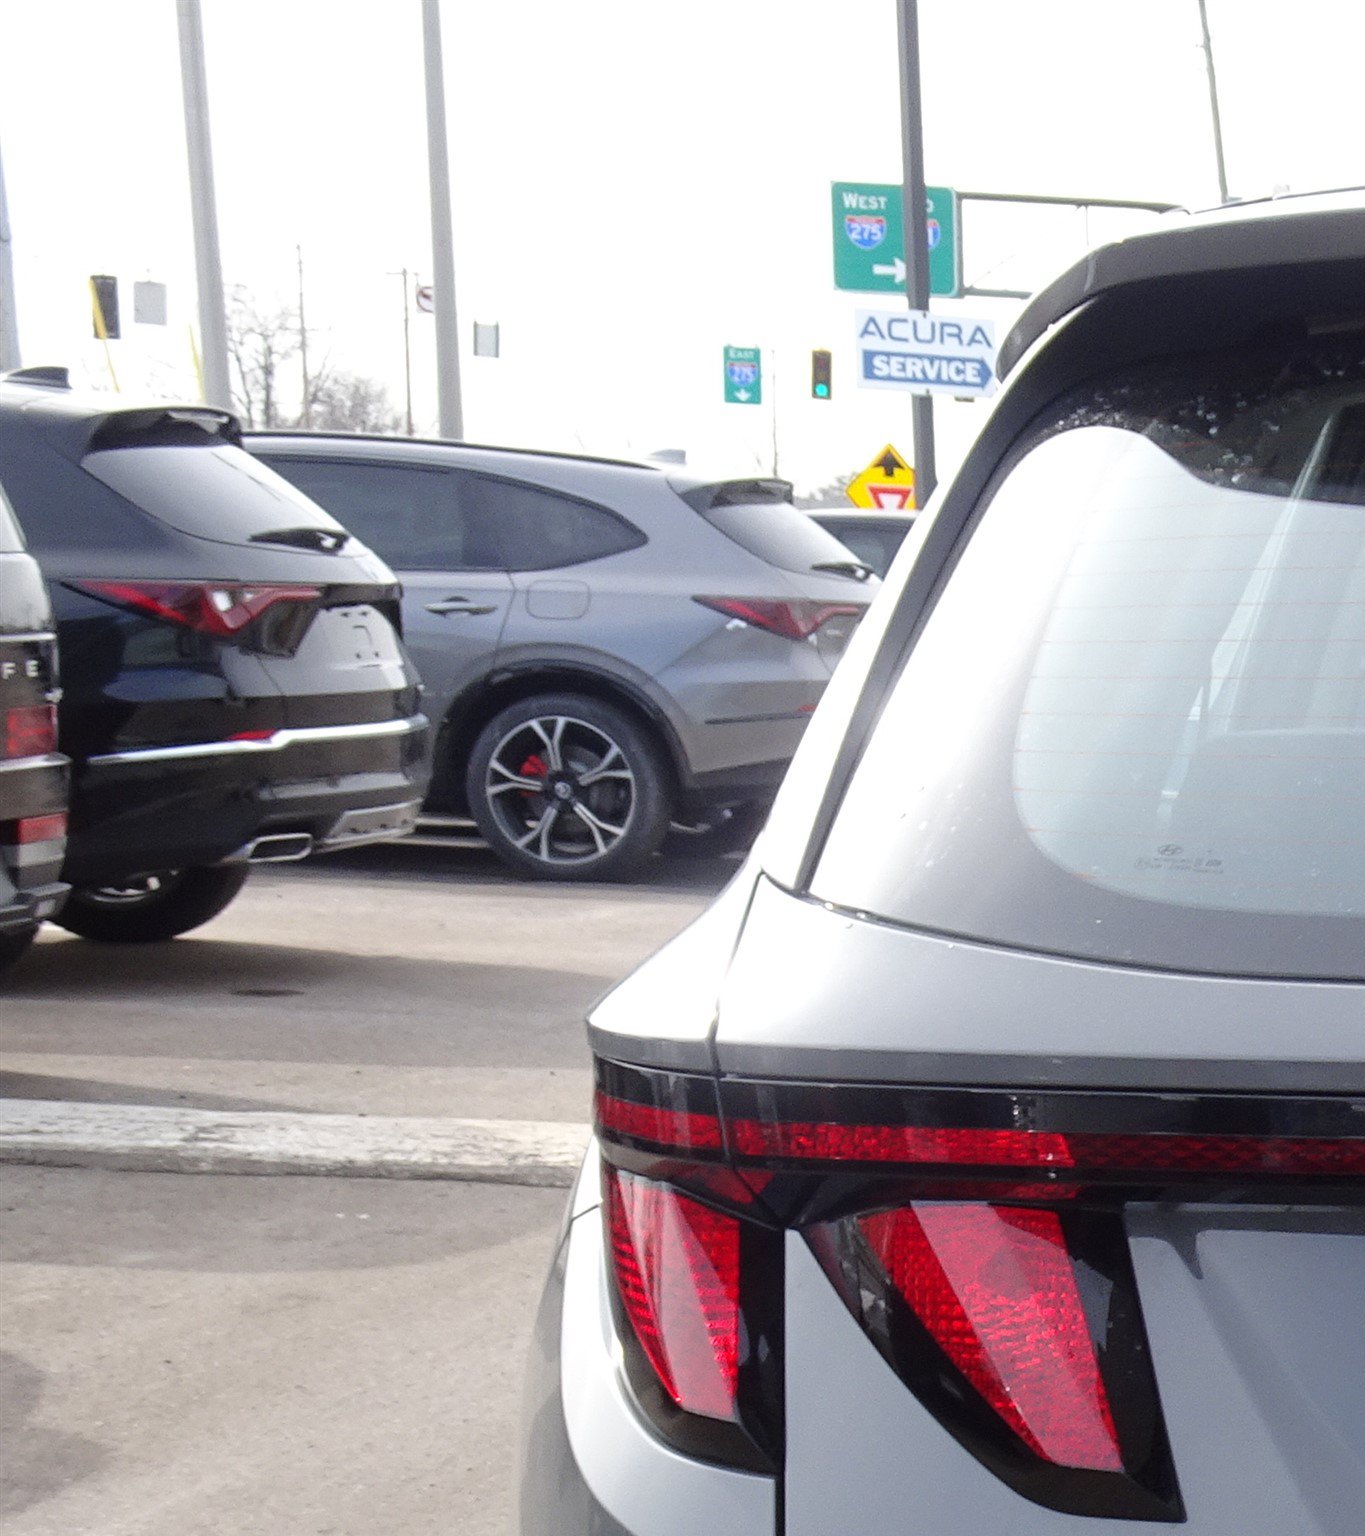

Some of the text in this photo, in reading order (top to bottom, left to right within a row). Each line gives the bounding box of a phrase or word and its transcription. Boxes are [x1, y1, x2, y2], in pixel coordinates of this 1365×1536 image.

[842, 191, 888, 210] WEST
[850, 222, 882, 241] 275
[859, 316, 993, 349] ACURA
[873, 354, 981, 384] SERVICE
